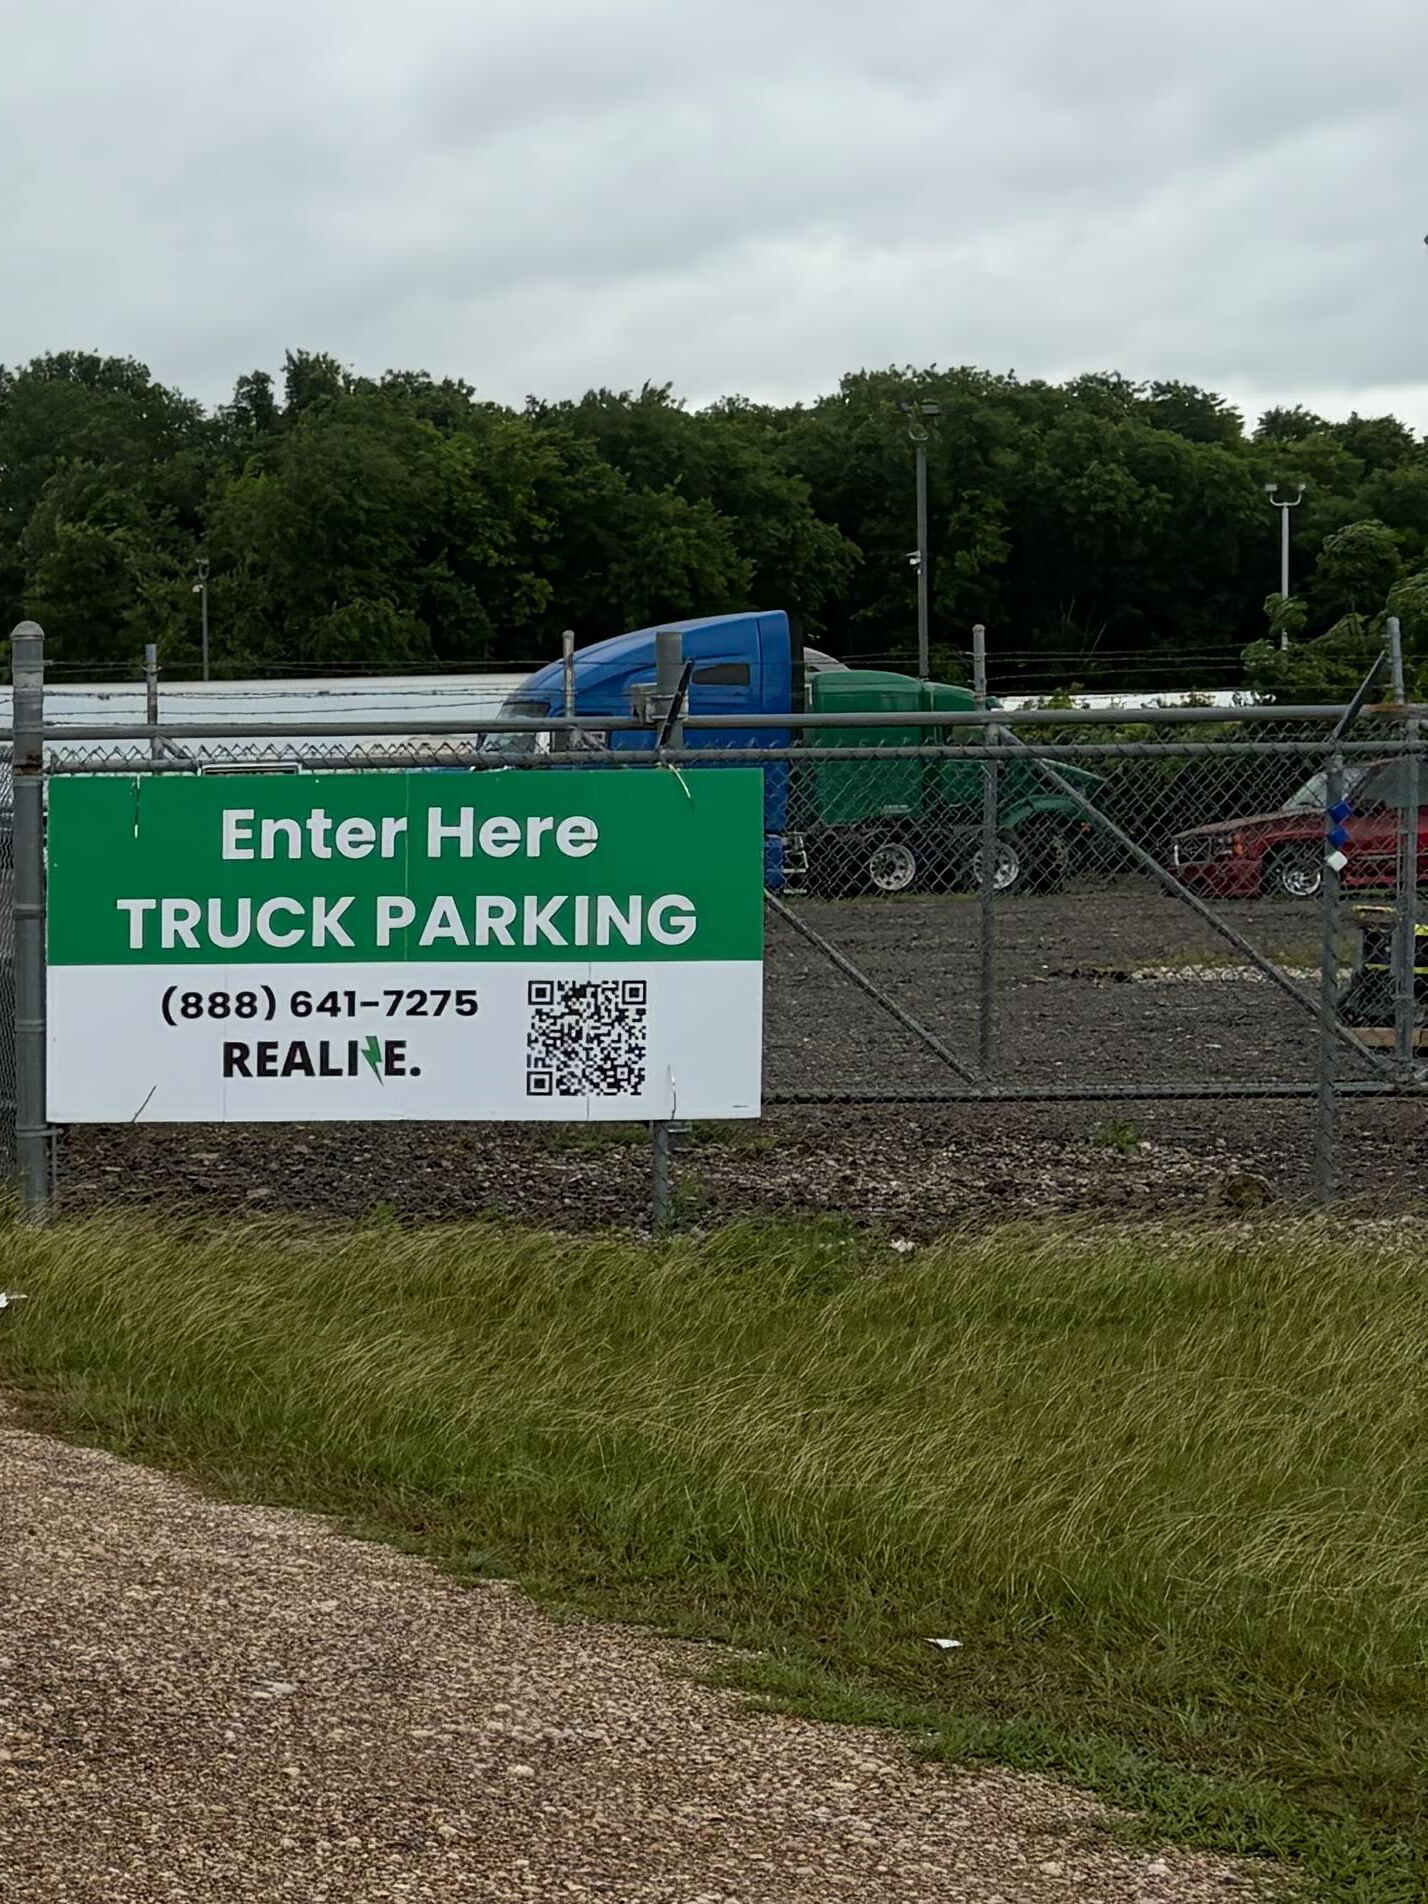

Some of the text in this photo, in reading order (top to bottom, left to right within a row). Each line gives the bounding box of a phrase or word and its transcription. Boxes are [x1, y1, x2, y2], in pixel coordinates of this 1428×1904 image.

[222, 806, 599, 860] Enter Here
[116, 894, 697, 949] TRUCK PARKING
[161, 985, 479, 1026] (888) 641-7275
[223, 1035, 421, 1087] REALIE.
